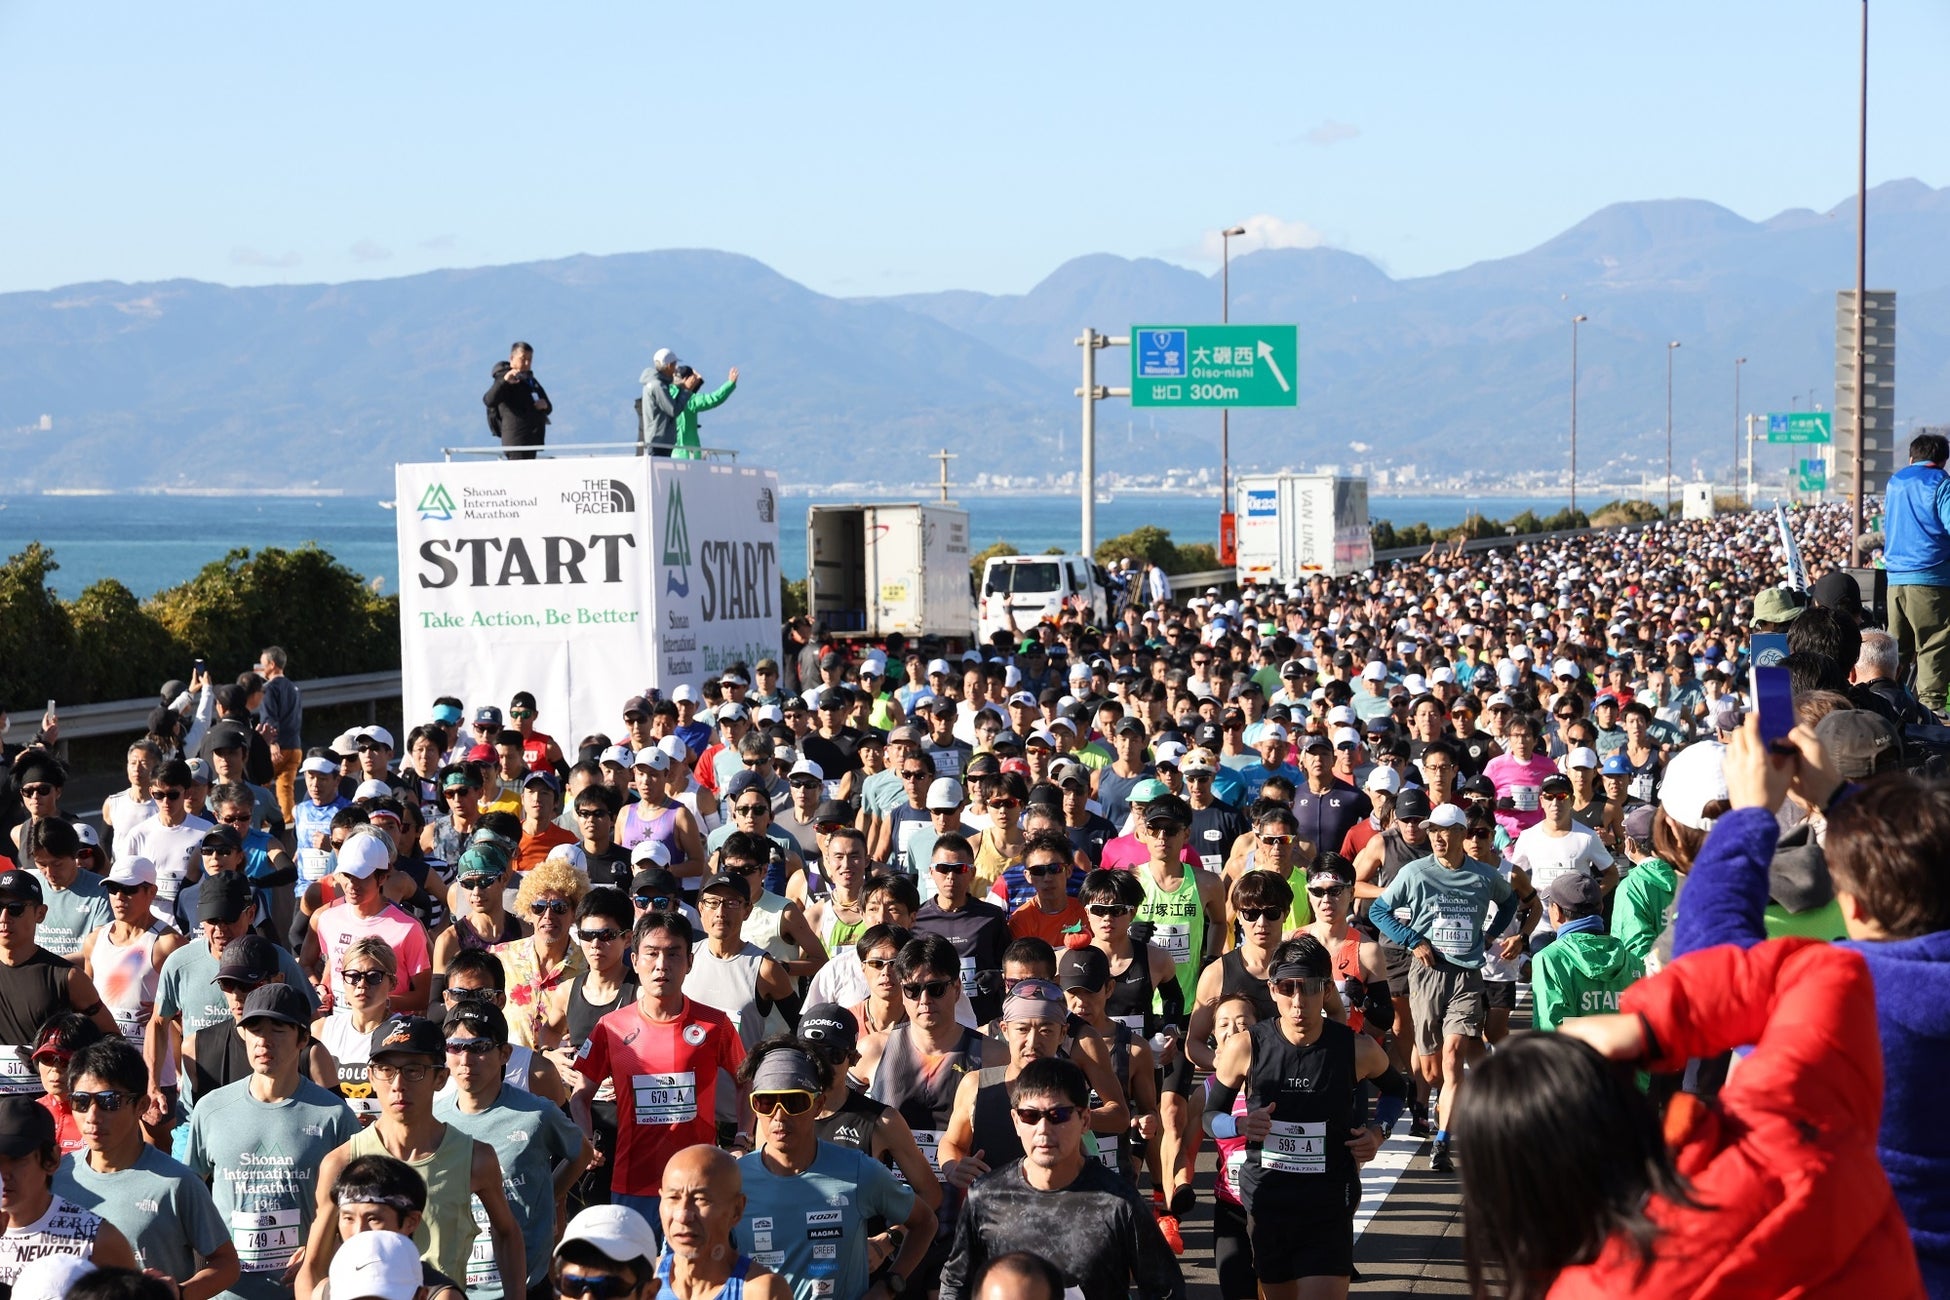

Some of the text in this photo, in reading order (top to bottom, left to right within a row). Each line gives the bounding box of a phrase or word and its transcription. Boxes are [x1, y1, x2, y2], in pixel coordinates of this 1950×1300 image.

[1146, 351, 1179, 366] 二宮
[1192, 346, 1253, 366] 大磯西
[1192, 367, 1253, 378] Oiso-nishi
[1152, 384, 1239, 400] 出口 300m
[583, 479, 609, 490] THE
[463, 487, 507, 498] Shonan
[561, 492, 609, 503] NORTH
[463, 497, 538, 508] International
[575, 503, 609, 514] FACE
[463, 509, 520, 520] Marathon
[1301, 489, 1315, 565] VAN LINES
[418, 533, 636, 589] START
[700, 540, 775, 622] START
[419, 606, 639, 629] Take Action, Be Better
[669, 610, 689, 629] Shonan
[662, 634, 697, 653] International
[1142, 903, 1197, 917] 平塚江南
[38, 924, 72, 934] Shonan
[131, 1026, 141, 1036] -A
[8, 1062, 22, 1074] 517
[1288, 1078, 1310, 1088] TRC
[651, 1090, 684, 1104] 679 -A
[1278, 1138, 1312, 1153] 593 -A
[240, 1152, 294, 1166] Shonan
[223, 1168, 311, 1181] International
[234, 1182, 300, 1194] Marathon
[254, 1200, 282, 1211] 19th
[248, 1232, 286, 1248] 749 -A
[810, 1229, 840, 1238] MAGMA
[16, 1245, 52, 1262] NEW
